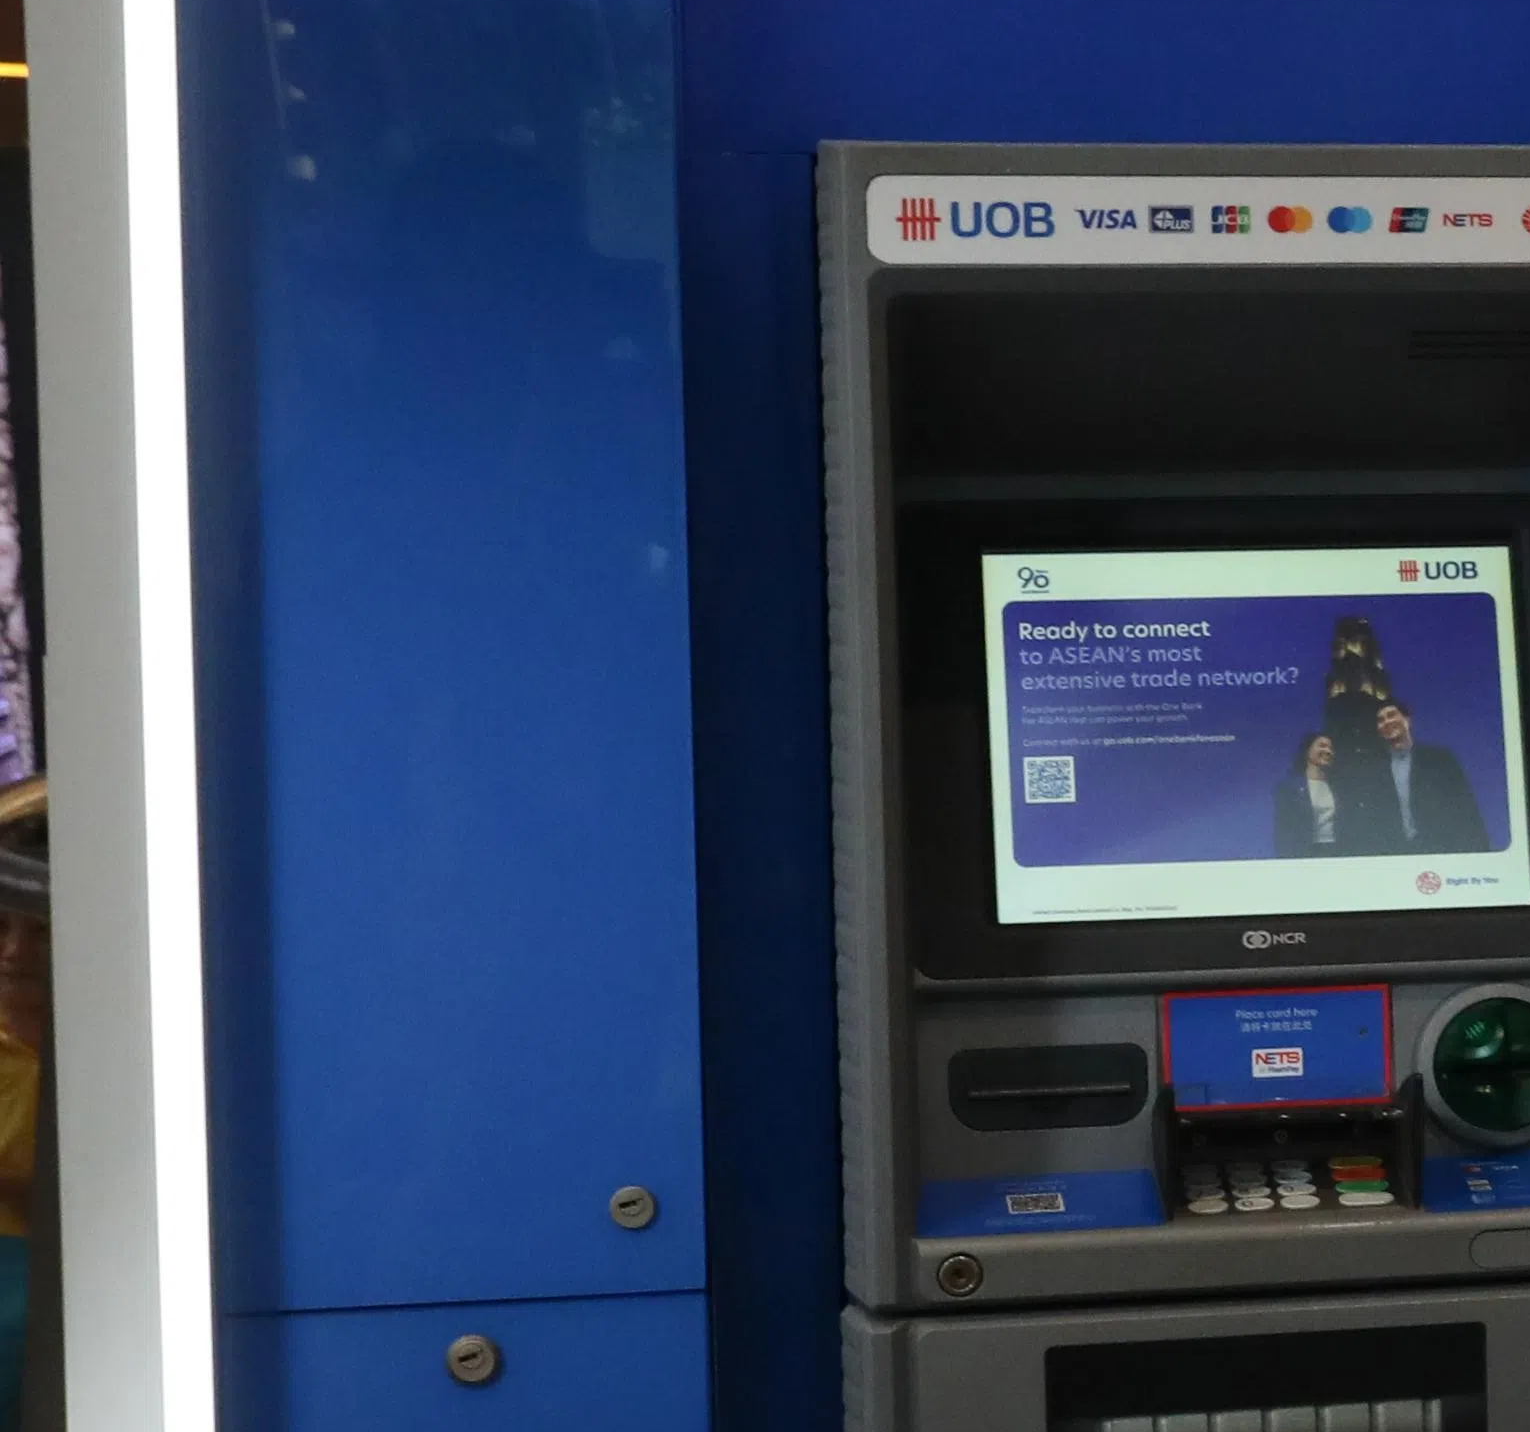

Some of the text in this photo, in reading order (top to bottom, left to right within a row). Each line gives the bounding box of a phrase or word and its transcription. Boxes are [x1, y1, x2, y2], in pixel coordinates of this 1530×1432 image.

[950, 201, 1056, 239] UOB
[1074, 208, 1138, 230] VISA
[1162, 217, 1192, 231] PLUS
[1442, 213, 1493, 227] NETS
[1423, 559, 1479, 581] UOB
[1018, 620, 1211, 646] Ready to connect
[1019, 647, 1043, 665] to
[1148, 644, 1203, 663] most
[1021, 665, 1299, 692] extensive trade network?
[1273, 932, 1306, 946] NCR
[1255, 1051, 1300, 1065] NETS
